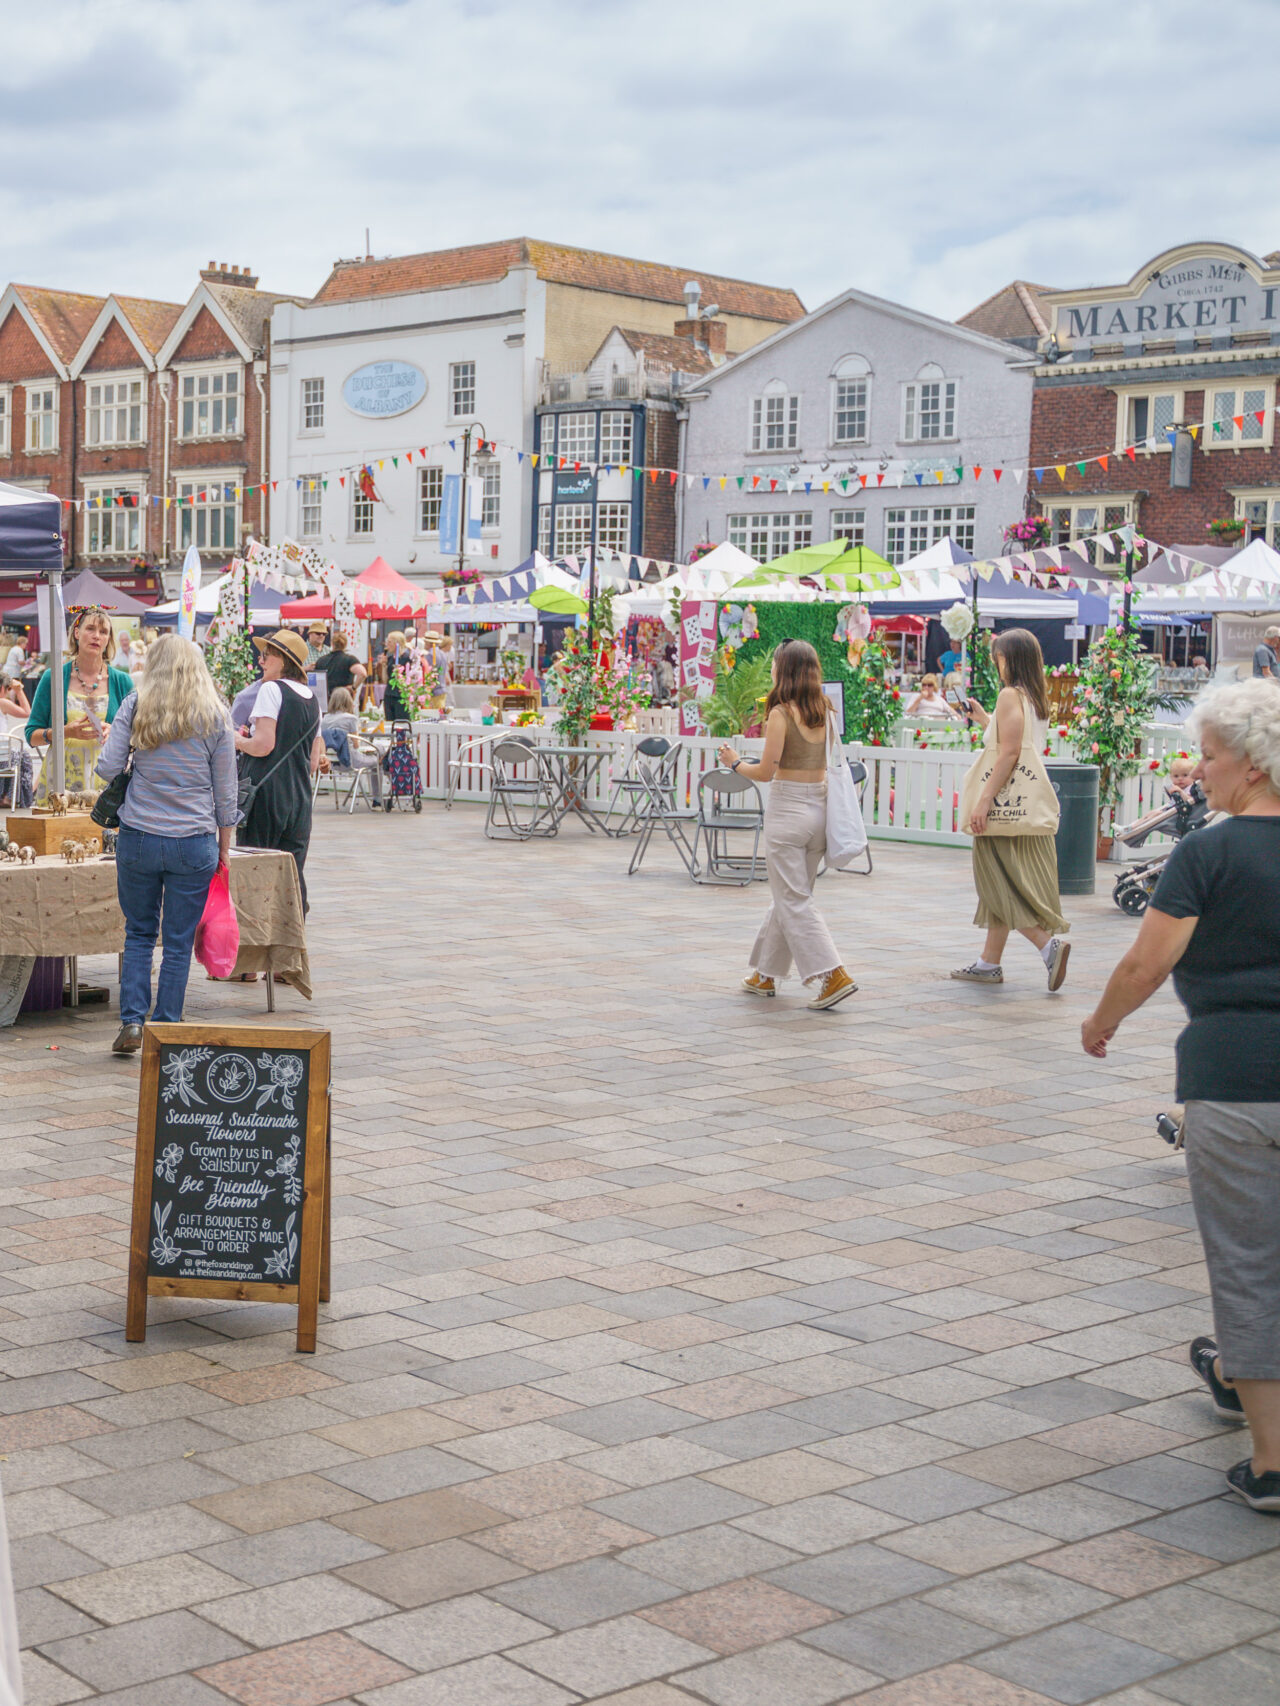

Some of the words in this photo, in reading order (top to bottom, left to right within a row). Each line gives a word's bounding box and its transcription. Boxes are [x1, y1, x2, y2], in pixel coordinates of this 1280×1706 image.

[1159, 269, 1203, 290] GIBBS
[1208, 264, 1246, 283] MEW
[1066, 296, 1247, 339] MARKET
[374, 364, 394, 375] THE
[352, 371, 417, 392] DUCHESS
[351, 391, 413, 412] ALBANY
[378, 390, 390, 398] OF
[1002, 809, 1028, 817] CHILL
[166, 1109, 224, 1126] Seasonal
[229, 1112, 300, 1129] Sustainable
[204, 1125, 257, 1142] Flowers
[190, 1141, 227, 1158] Grown
[229, 1145, 242, 1160] by
[246, 1148, 259, 1159] us
[261, 1148, 273, 1160] in
[199, 1158, 260, 1175] Salisbury
[179, 1175, 204, 1194] Bee
[206, 1175, 276, 1201] Friendly
[204, 1193, 259, 1211] Blooms
[178, 1213, 202, 1226] GIFT
[205, 1215, 258, 1229] BOUQUETS
[262, 1217, 272, 1229] &
[173, 1227, 257, 1243] ARRANGEMENTS
[259, 1231, 285, 1244] MADE
[202, 1240, 214, 1251] TO
[217, 1241, 249, 1254] ORDER
[195, 1258, 254, 1271] @thefoxanddingo
[179, 1268, 263, 1280] www.thefoxanddingo.com
